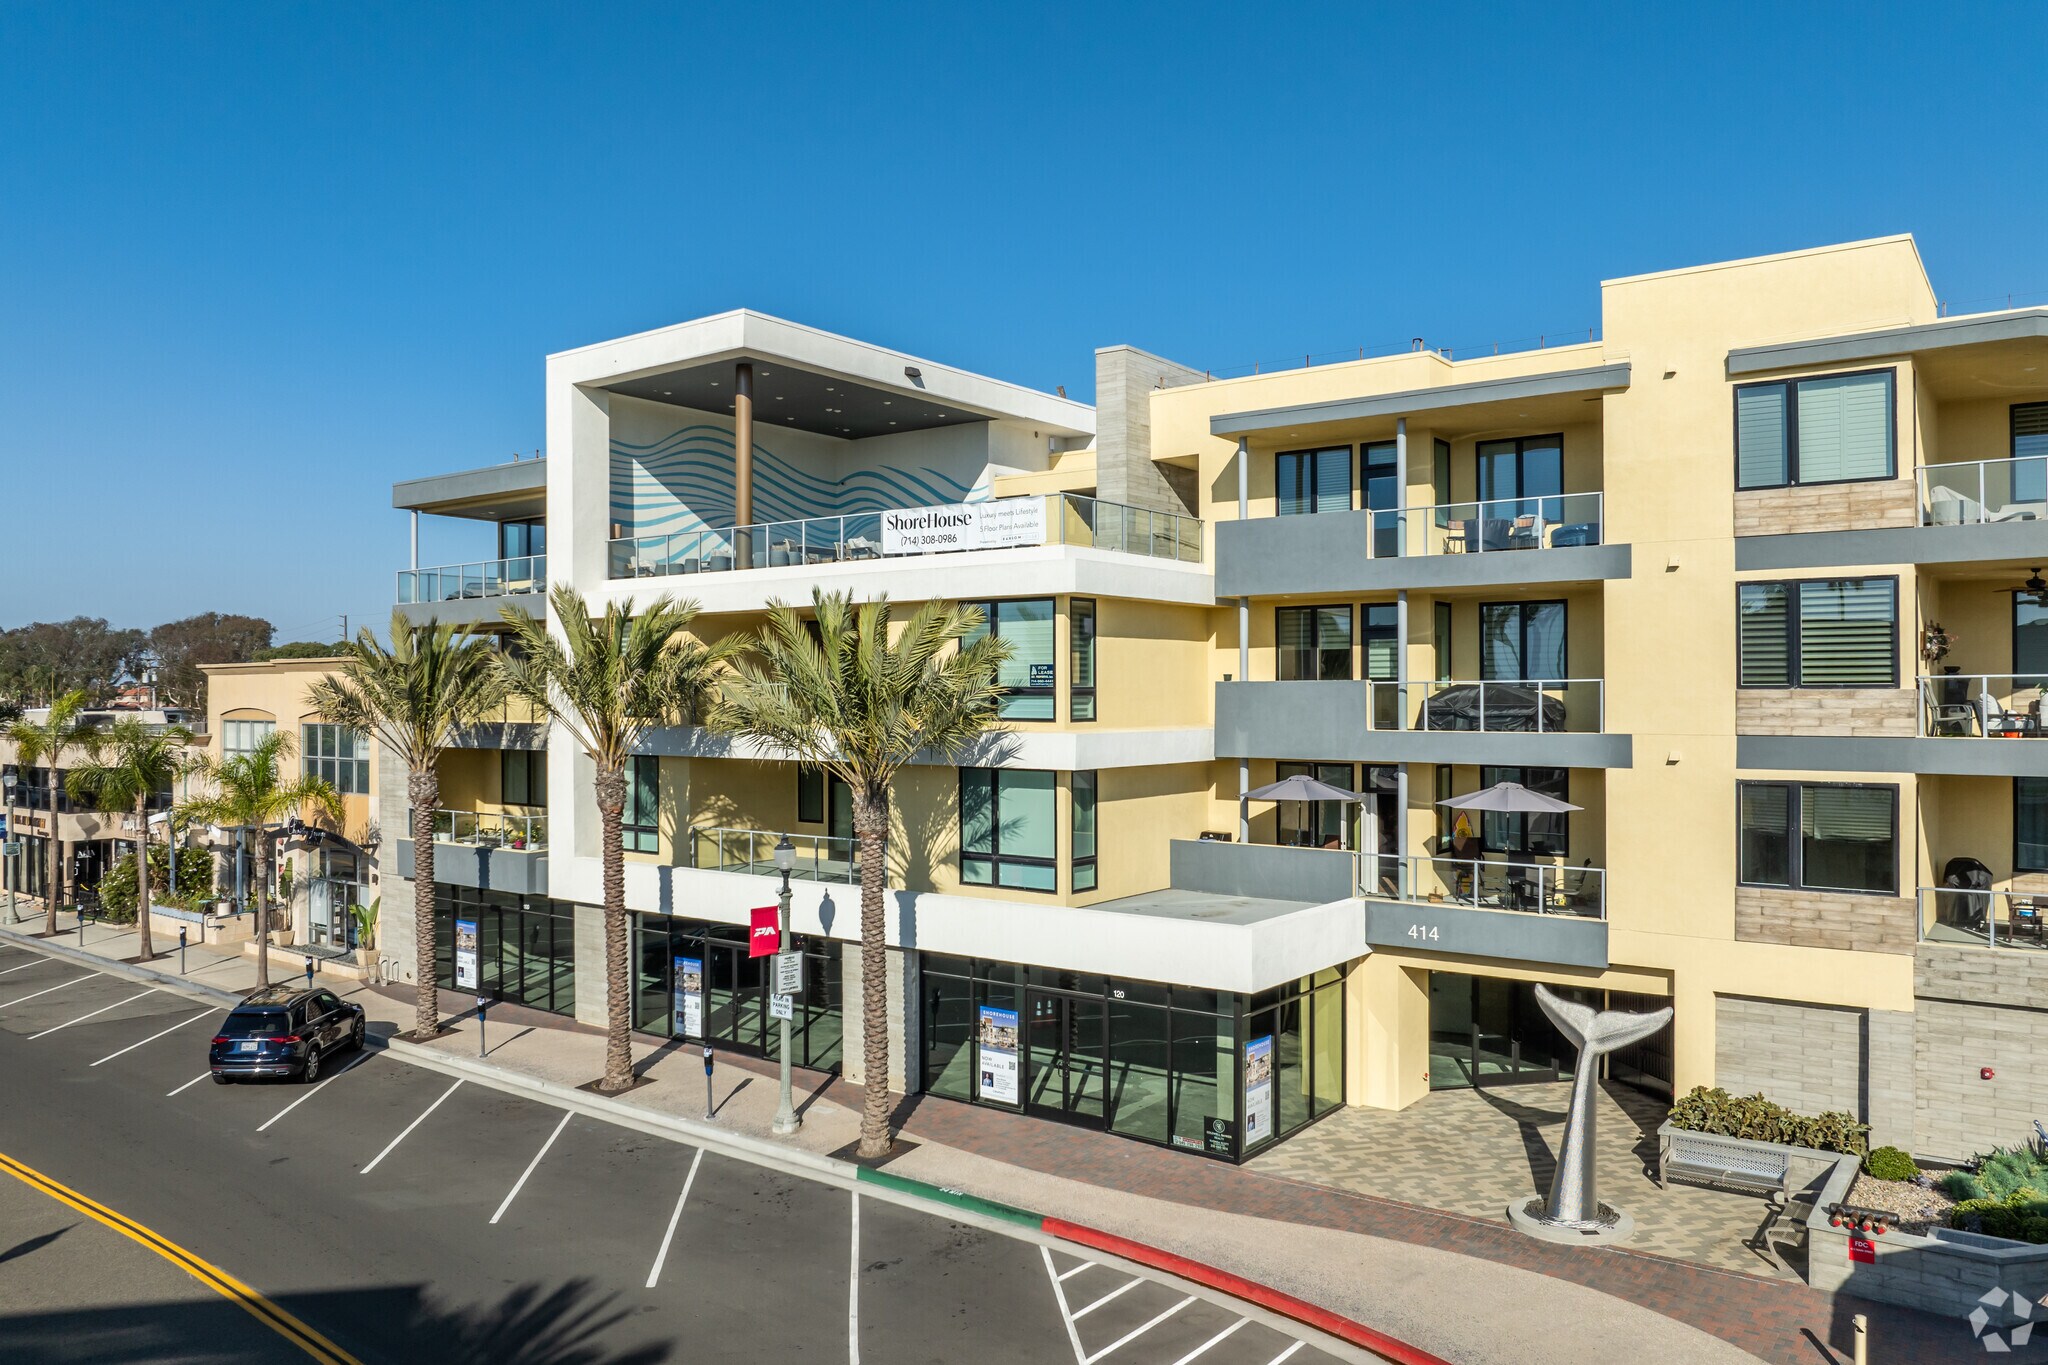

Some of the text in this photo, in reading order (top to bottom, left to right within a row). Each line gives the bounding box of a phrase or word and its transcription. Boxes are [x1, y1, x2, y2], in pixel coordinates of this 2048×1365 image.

[1015, 507, 1038, 516] Lifestyle
[887, 513, 972, 531] ShoreHouse
[998, 523, 1012, 531] Plans
[1013, 521, 1039, 529] Available
[900, 533, 958, 547] (714) 308-0986
[1407, 924, 1440, 941] 414
[1113, 990, 1125, 999] 120
[772, 1001, 790, 1010] PARKING
[982, 1010, 1016, 1020] SHOREHOUSE
[981, 1061, 1005, 1070] AVAILABLE
[1855, 1240, 1869, 1248] FDC
